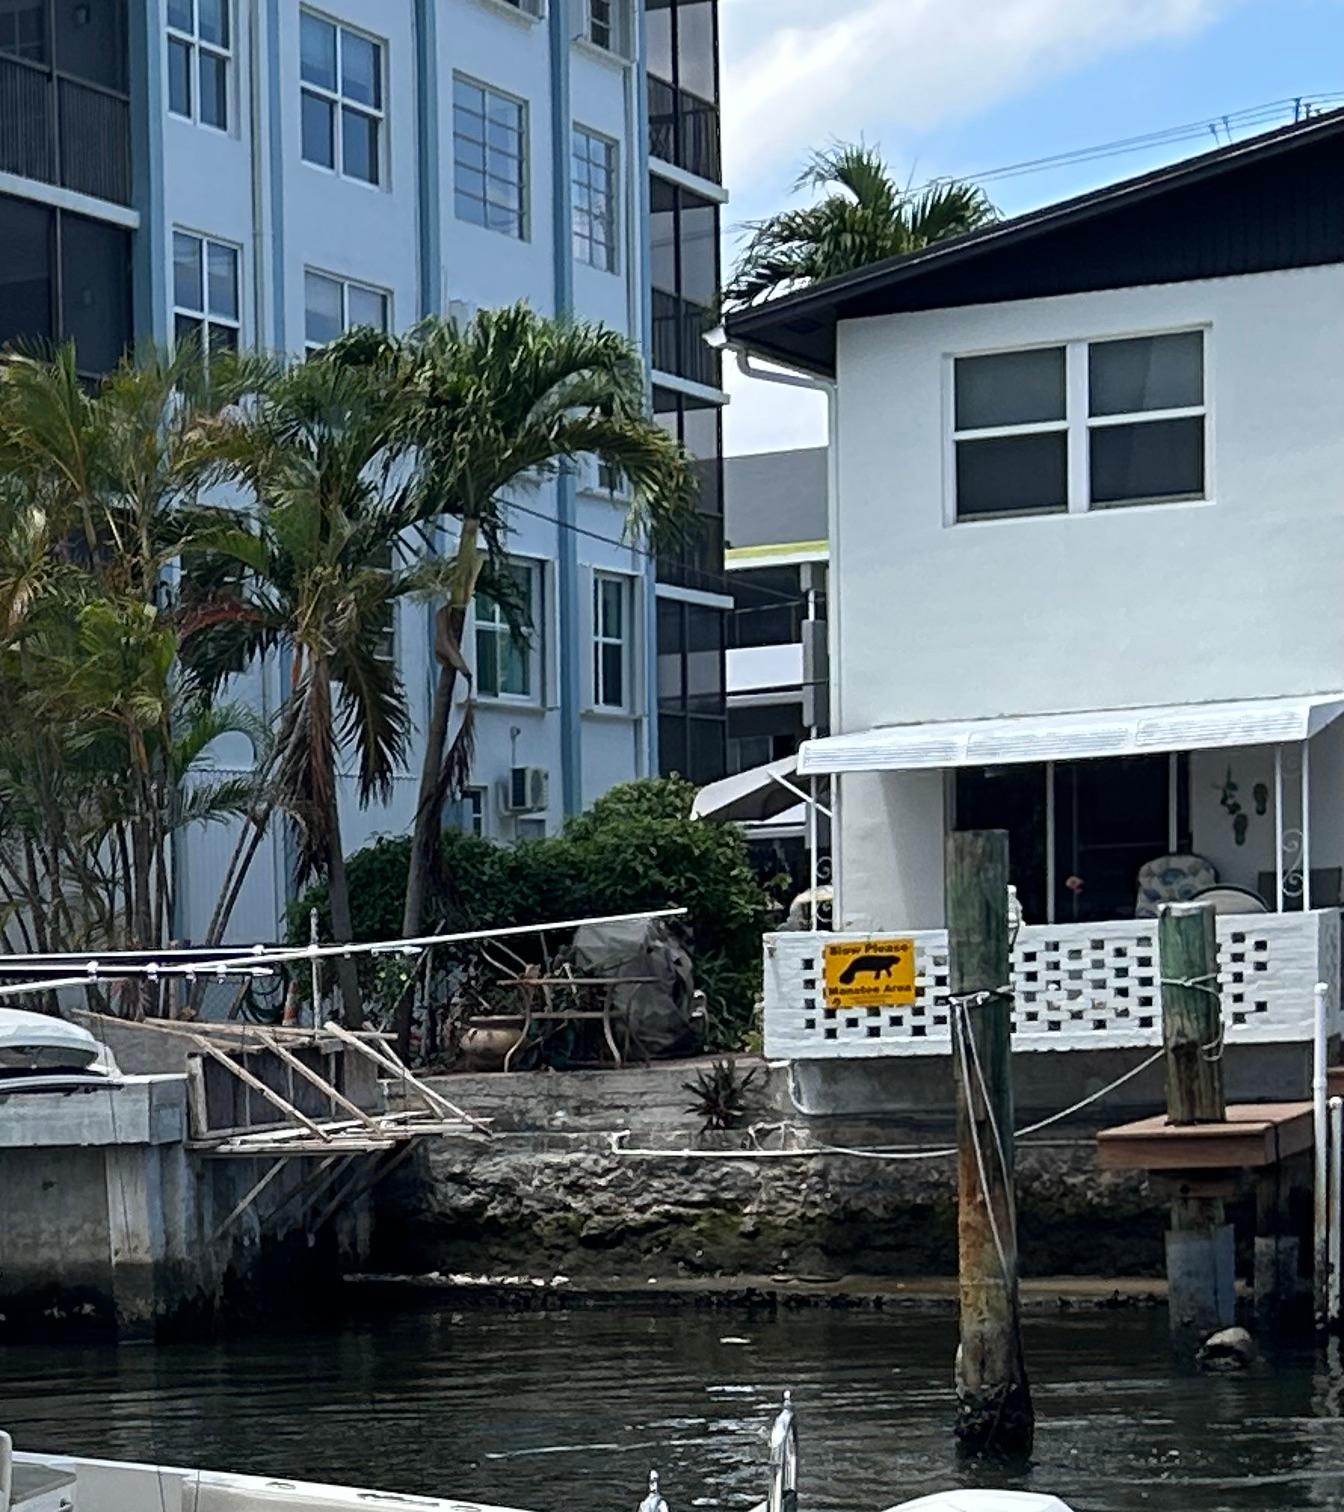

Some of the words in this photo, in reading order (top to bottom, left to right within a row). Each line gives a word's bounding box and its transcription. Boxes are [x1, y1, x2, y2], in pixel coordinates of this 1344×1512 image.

[829, 946, 861, 956] Slow
[865, 943, 909, 953] Please
[828, 986, 880, 995] Manatee
[883, 984, 912, 993] Area
